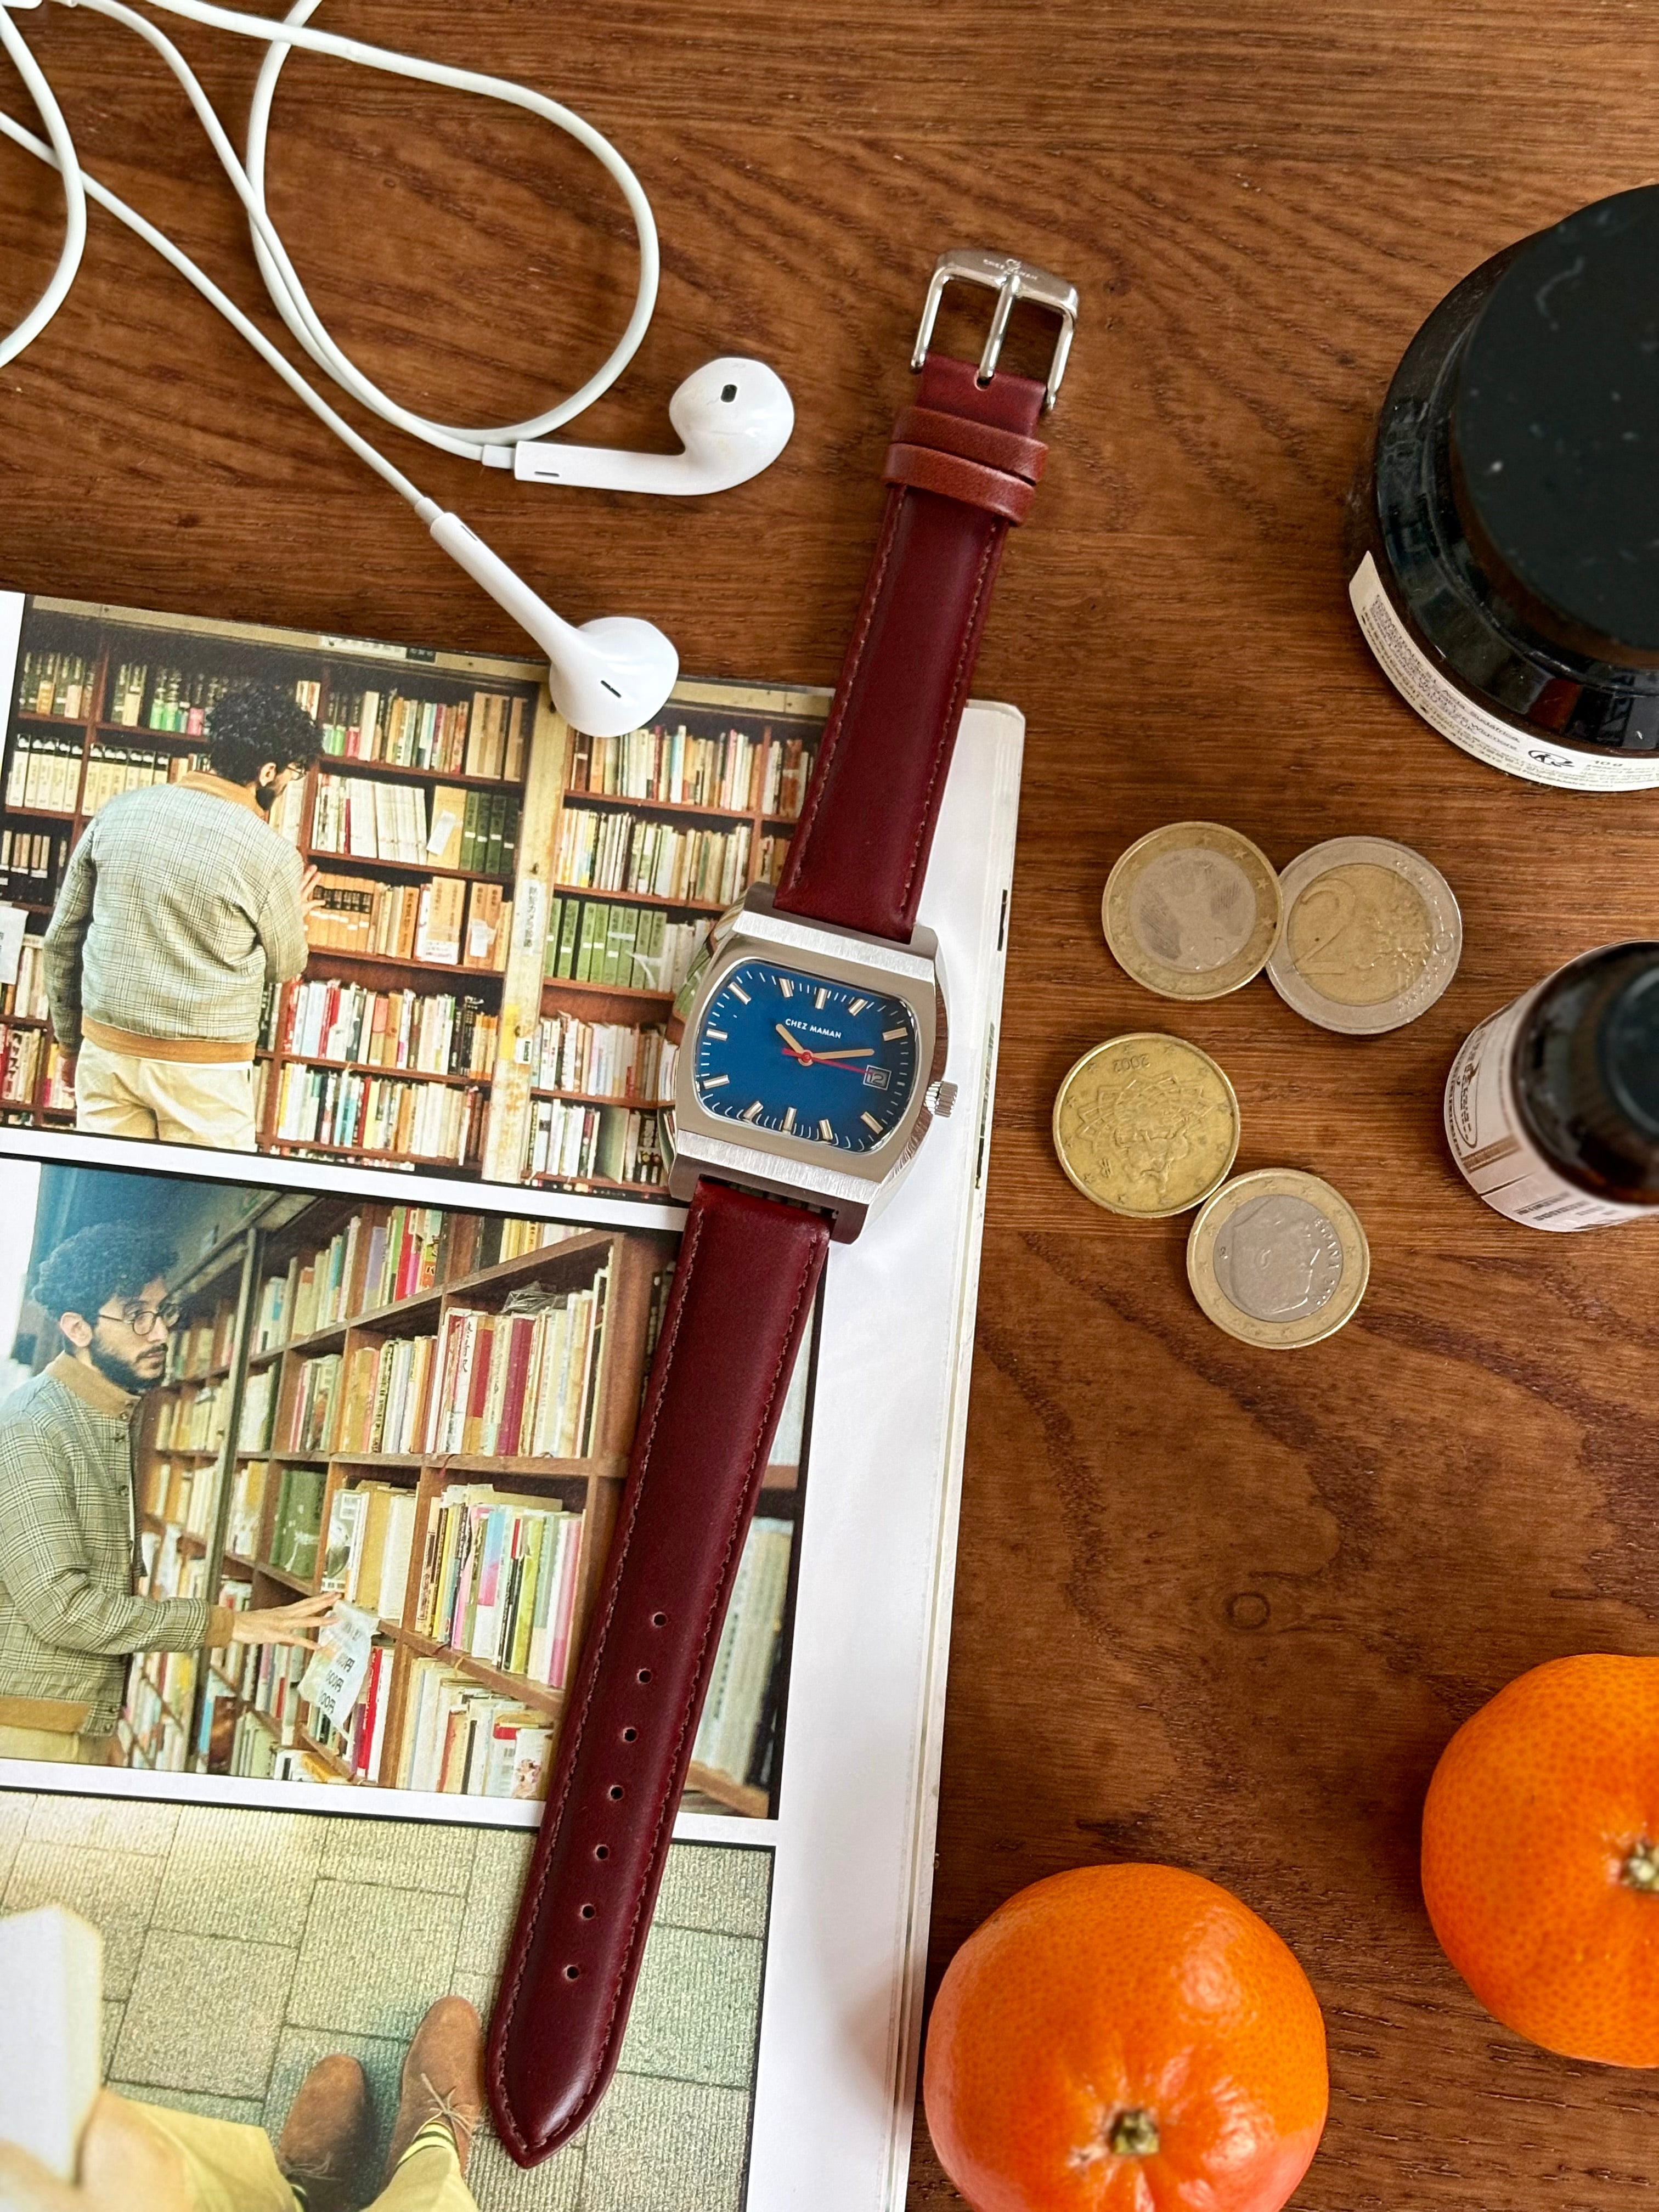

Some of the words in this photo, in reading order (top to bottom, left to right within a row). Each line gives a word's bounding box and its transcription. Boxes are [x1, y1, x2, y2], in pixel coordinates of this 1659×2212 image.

[1293, 878, 1355, 975] 2
[785, 1018, 808, 1030] CHEZ
[810, 1025, 842, 1039] MAMAN
[1113, 1053, 1150, 1073] 2002
